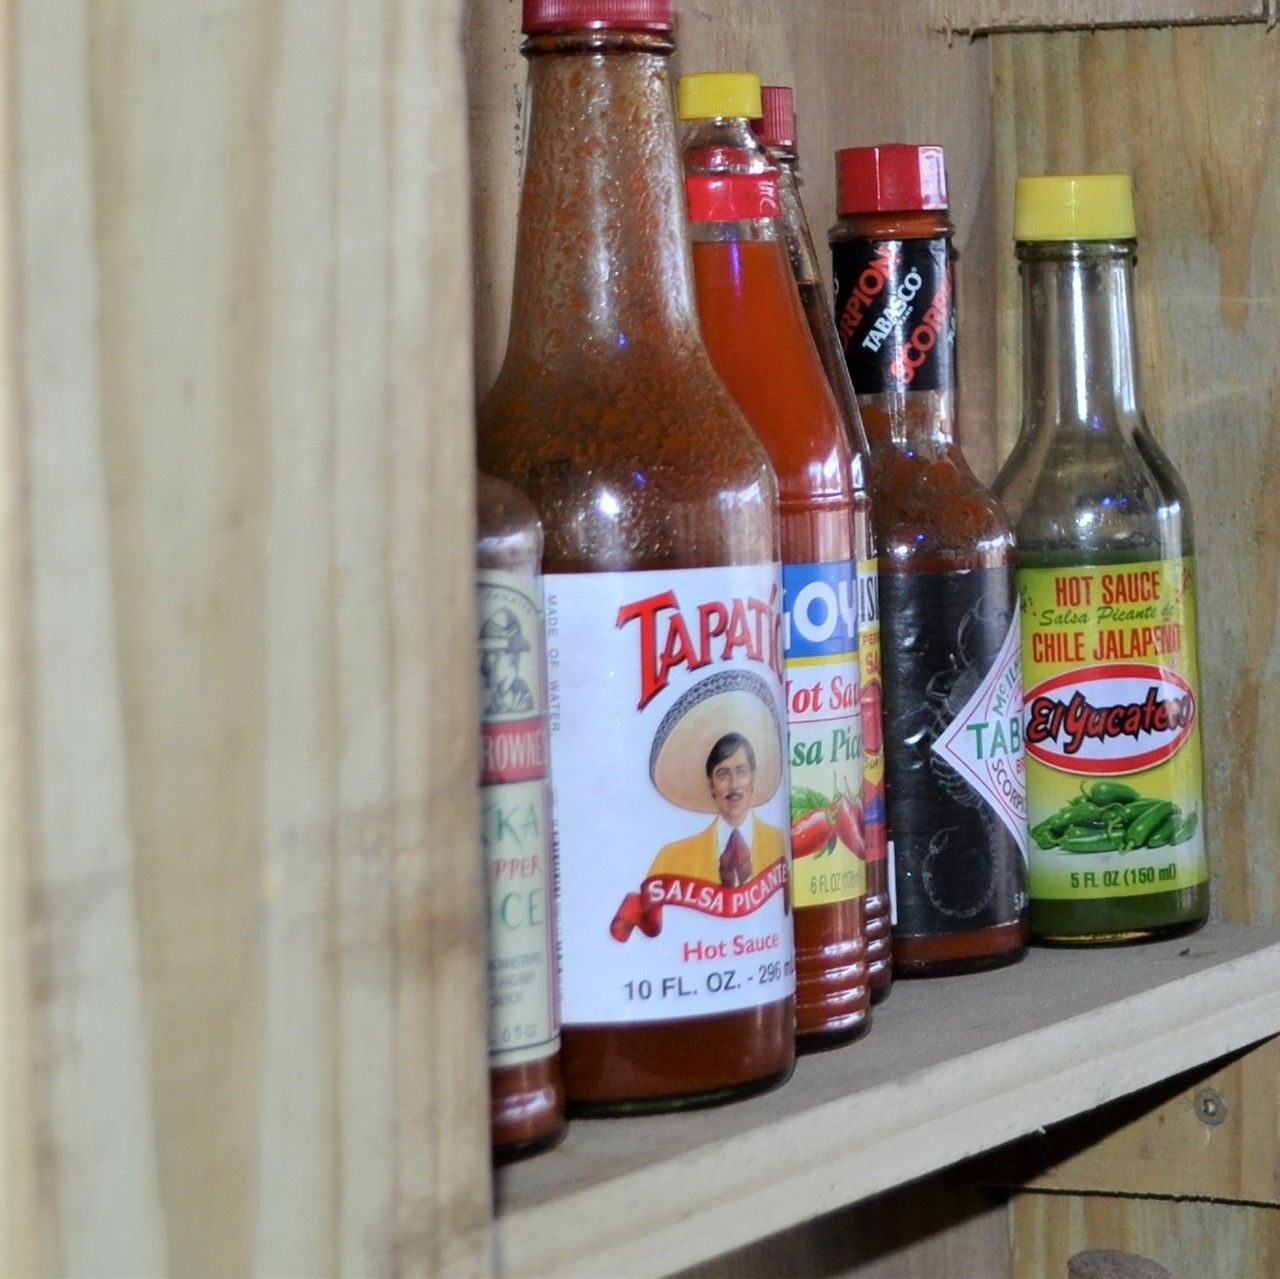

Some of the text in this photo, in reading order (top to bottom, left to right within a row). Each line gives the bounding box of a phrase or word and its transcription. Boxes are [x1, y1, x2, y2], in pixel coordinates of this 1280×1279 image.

[861, 271, 923, 353] TABASCO
[1055, 570, 1161, 608] HOT SAUCE
[784, 580, 857, 651] OY
[1039, 608, 1090, 627] Salsa
[1097, 604, 1158, 625] Picante
[1032, 631, 1086, 664] CHILE
[647, 861, 788, 914] SALSA PICANTE
[1070, 872, 1079, 889] 5
[1103, 871, 1120, 887] OZ
[1123, 866, 1154, 886] (150
[1158, 862, 1177, 882] ml)
[682, 932, 780, 963] Hot Sauce
[623, 978, 652, 1002] 10
[661, 975, 698, 999] FL.
[706, 969, 742, 994] OZ.
[758, 960, 782, 985] 296
